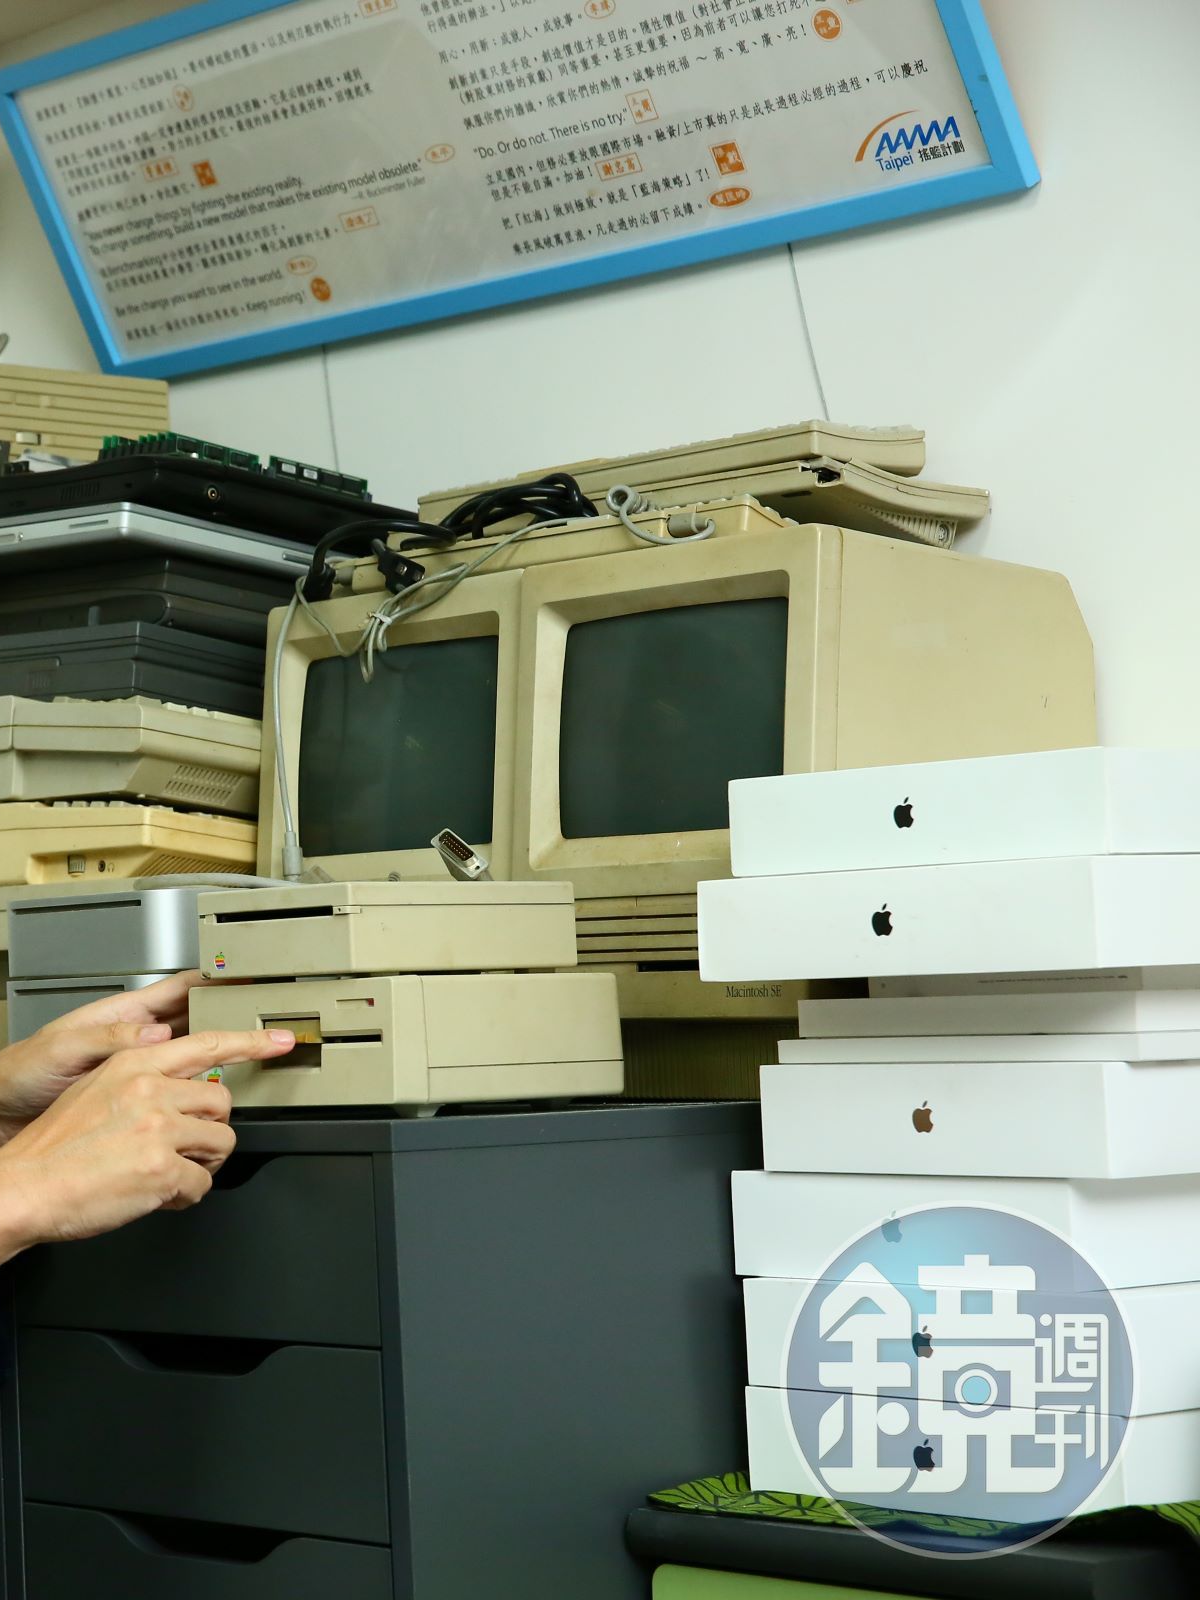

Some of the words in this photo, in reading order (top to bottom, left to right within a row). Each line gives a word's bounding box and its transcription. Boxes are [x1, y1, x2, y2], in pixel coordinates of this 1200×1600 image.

[497, 141, 511, 154] Or
[512, 137, 527, 150] do
[528, 131, 549, 146] not.
[549, 124, 579, 141] There
[580, 119, 590, 132] is
[591, 117, 606, 130] no
[875, 151, 914, 172] Taipei
[102, 225, 124, 237] never
[125, 217, 154, 231] change
[155, 209, 181, 224] things
[180, 206, 192, 218] by
[191, 198, 226, 214] fighting
[225, 192, 240, 204] the
[241, 184, 275, 200] existing
[275, 176, 302, 191] reality.
[173, 220, 196, 235] build
[202, 216, 220, 227] new
[221, 205, 248, 221] model
[248, 201, 268, 214] that
[267, 195, 296, 209] makes
[296, 189, 311, 201] the
[312, 181, 347, 198] existing
[347, 170, 377, 189] model
[126, 303, 140, 315] the
[141, 297, 169, 311] change
[171, 294, 186, 307] you
[187, 287, 206, 300] want
[206, 285, 218, 296] to
[217, 283, 231, 293] see
[241, 275, 256, 288] the
[257, 267, 283, 283] world.
[725, 983, 768, 998] Macintosh
[770, 984, 782, 997] SE
